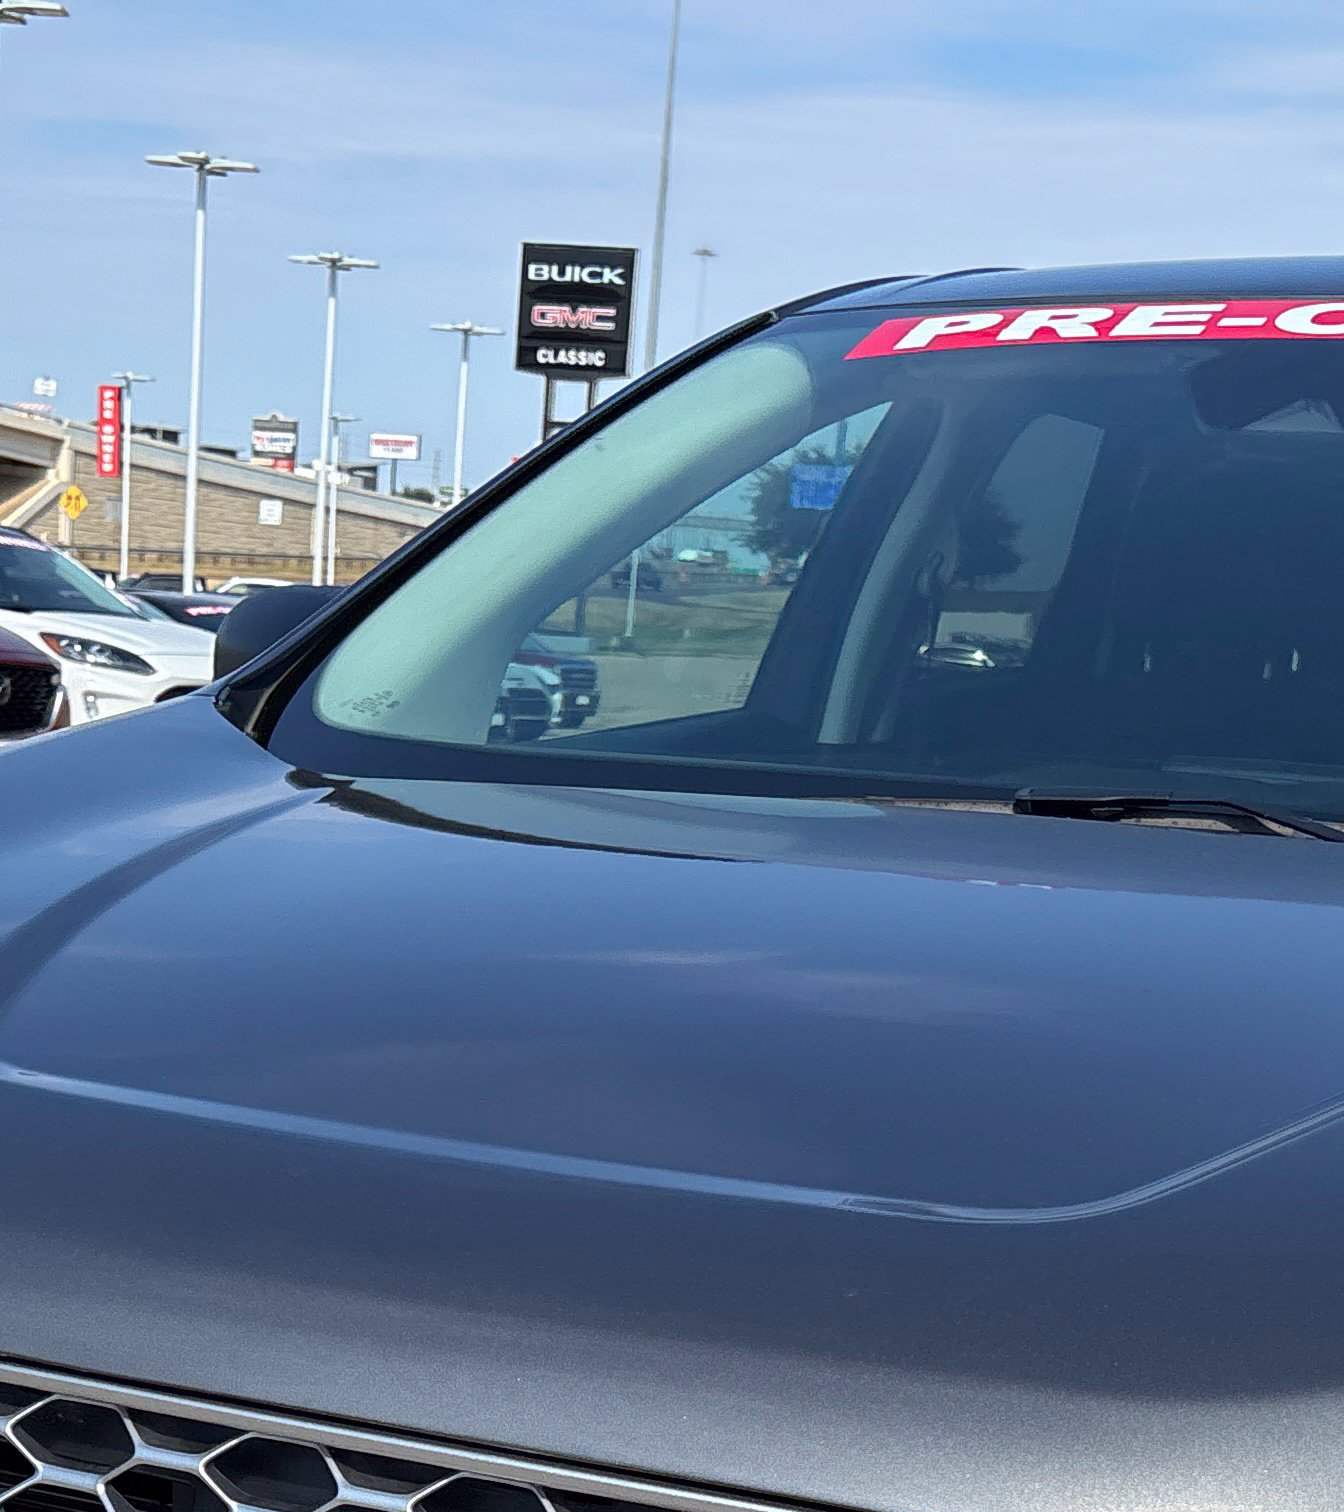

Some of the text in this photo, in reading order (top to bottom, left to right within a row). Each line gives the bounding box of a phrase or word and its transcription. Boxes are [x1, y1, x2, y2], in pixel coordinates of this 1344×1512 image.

[527, 262, 626, 285] BUICK
[531, 303, 617, 330] GMC
[536, 348, 606, 367] CLASSIC
